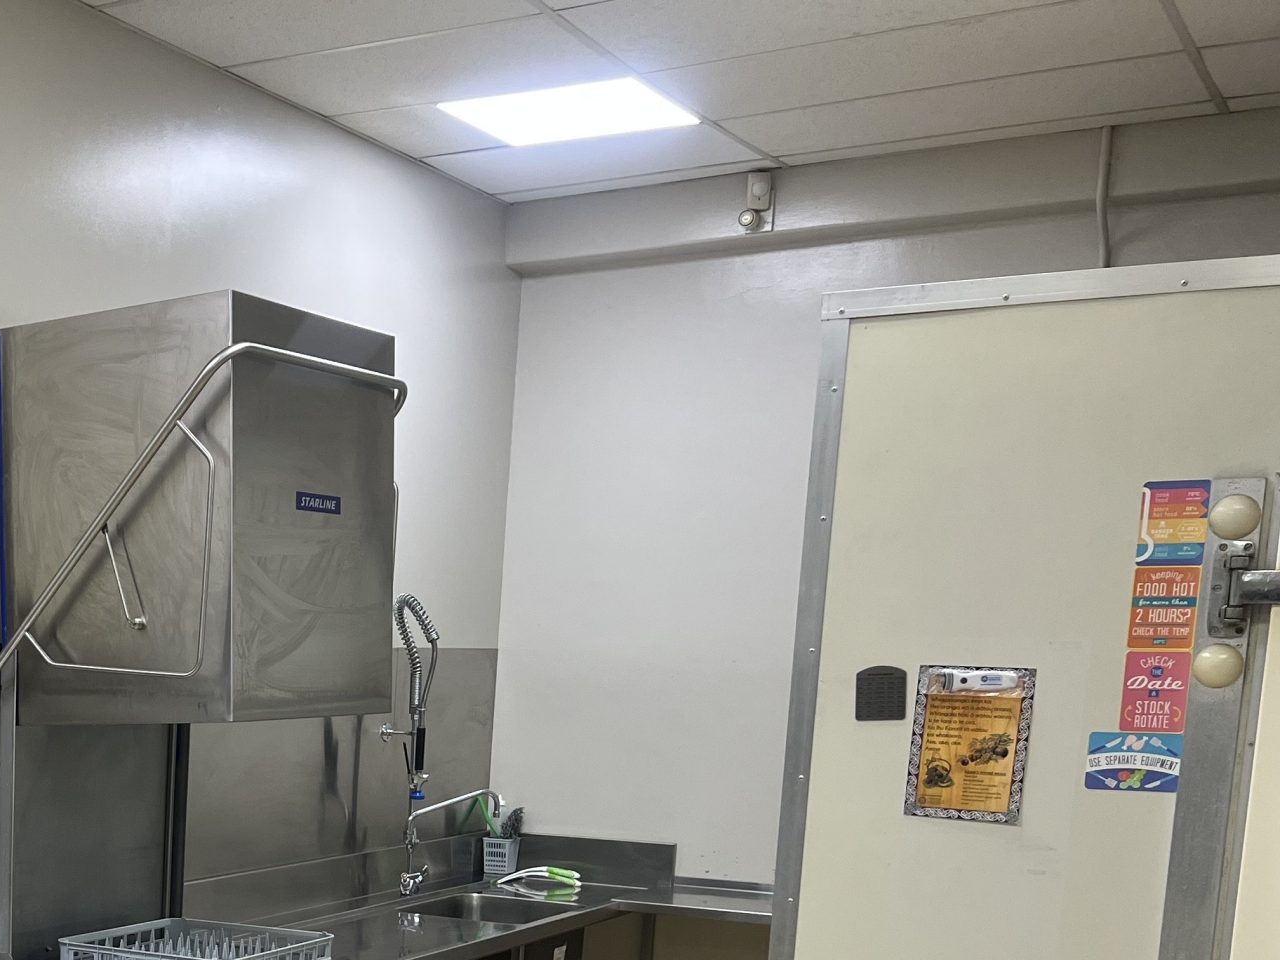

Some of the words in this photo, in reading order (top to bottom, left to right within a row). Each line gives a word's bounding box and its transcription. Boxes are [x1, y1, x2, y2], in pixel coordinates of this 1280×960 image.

[301, 496, 337, 510] STARLINE
[1150, 571, 1184, 582] keeping
[1136, 582, 1167, 597] FOOD
[1172, 582, 1196, 597] HOT
[1138, 598, 1151, 607] for
[1135, 608, 1143, 623] 2
[1148, 608, 1191, 623] HOURS?
[1132, 627, 1155, 636] CHECK
[1157, 627, 1170, 636] THE
[1172, 627, 1190, 636] TEMP
[1140, 655, 1176, 669] CHECK
[1126, 675, 1185, 690] Date
[1135, 700, 1171, 714] STOCK
[1133, 714, 1169, 729] ROTATE
[1088, 756, 1102, 768] USE
[1104, 755, 1137, 766] SEPARATE
[1140, 755, 1179, 771] EQUIPMENT
